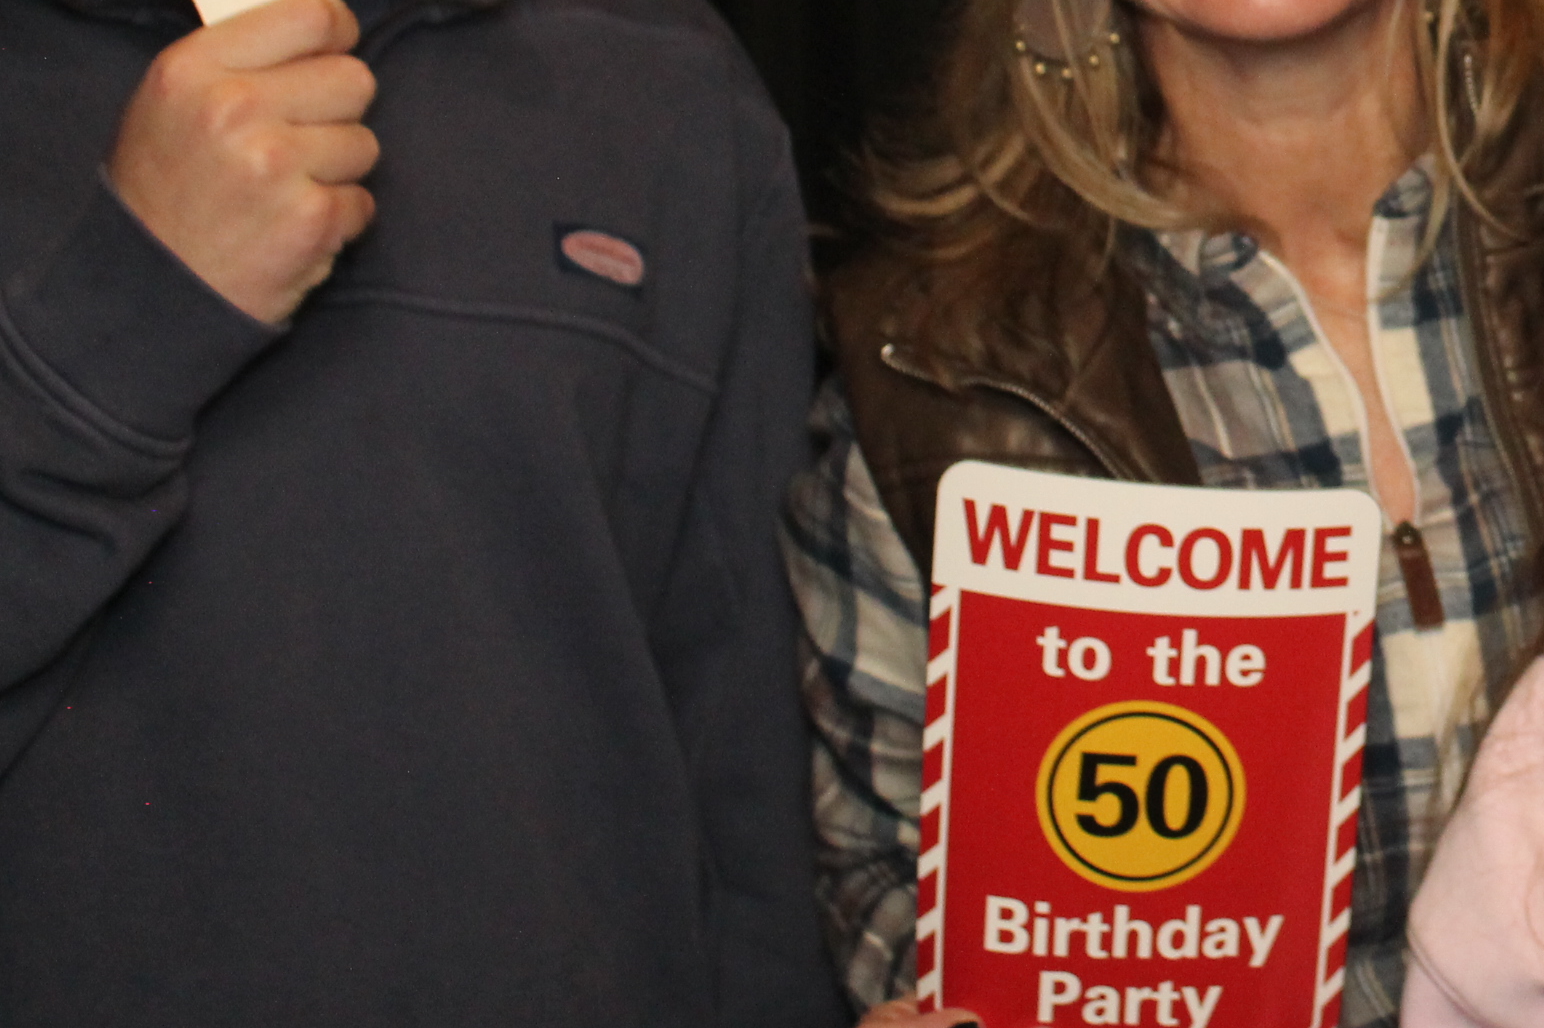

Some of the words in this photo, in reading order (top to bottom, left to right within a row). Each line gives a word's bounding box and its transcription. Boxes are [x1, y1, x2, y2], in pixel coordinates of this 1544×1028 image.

[962, 498, 1353, 591] WELCOME
[1035, 626, 1112, 681] to
[1146, 628, 1267, 687] the
[1074, 751, 1210, 840] 50
[983, 894, 1284, 968] Birthday
[1036, 970, 1224, 1028] Party
